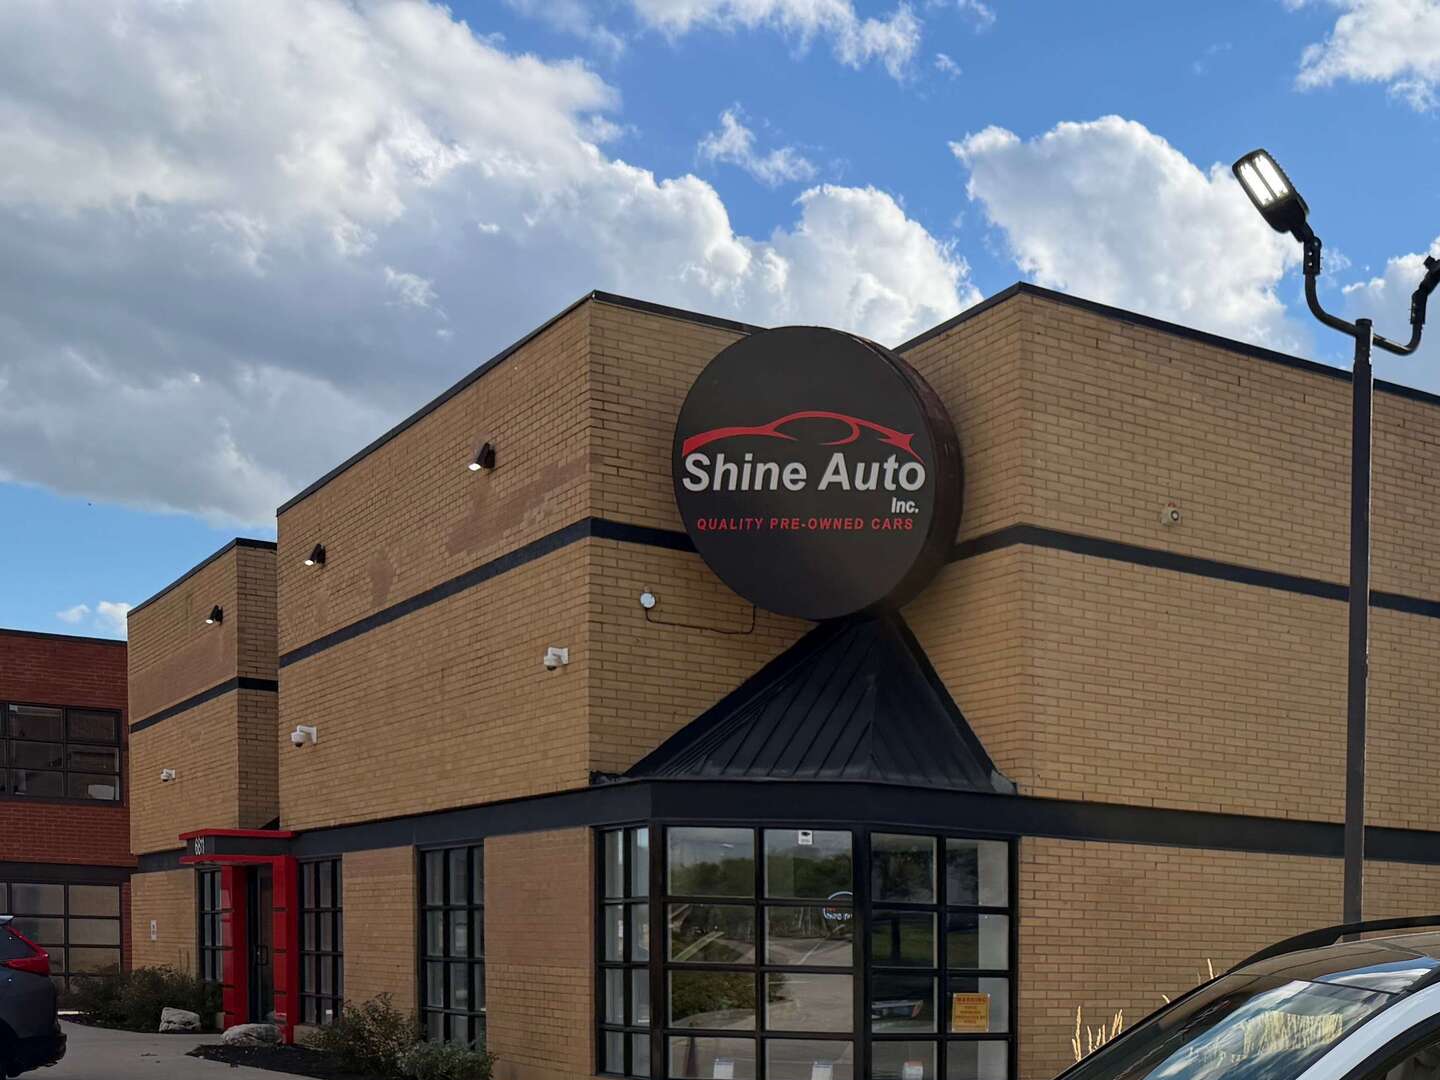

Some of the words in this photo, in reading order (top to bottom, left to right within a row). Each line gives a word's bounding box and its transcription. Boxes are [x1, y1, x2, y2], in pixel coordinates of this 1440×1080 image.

[682, 452, 807, 491] Shine
[817, 452, 926, 491] Auto
[891, 496, 919, 513] Inc.
[697, 518, 763, 530] QUALITY
[769, 518, 864, 530] PRE-OWNED
[871, 518, 913, 530] CARS
